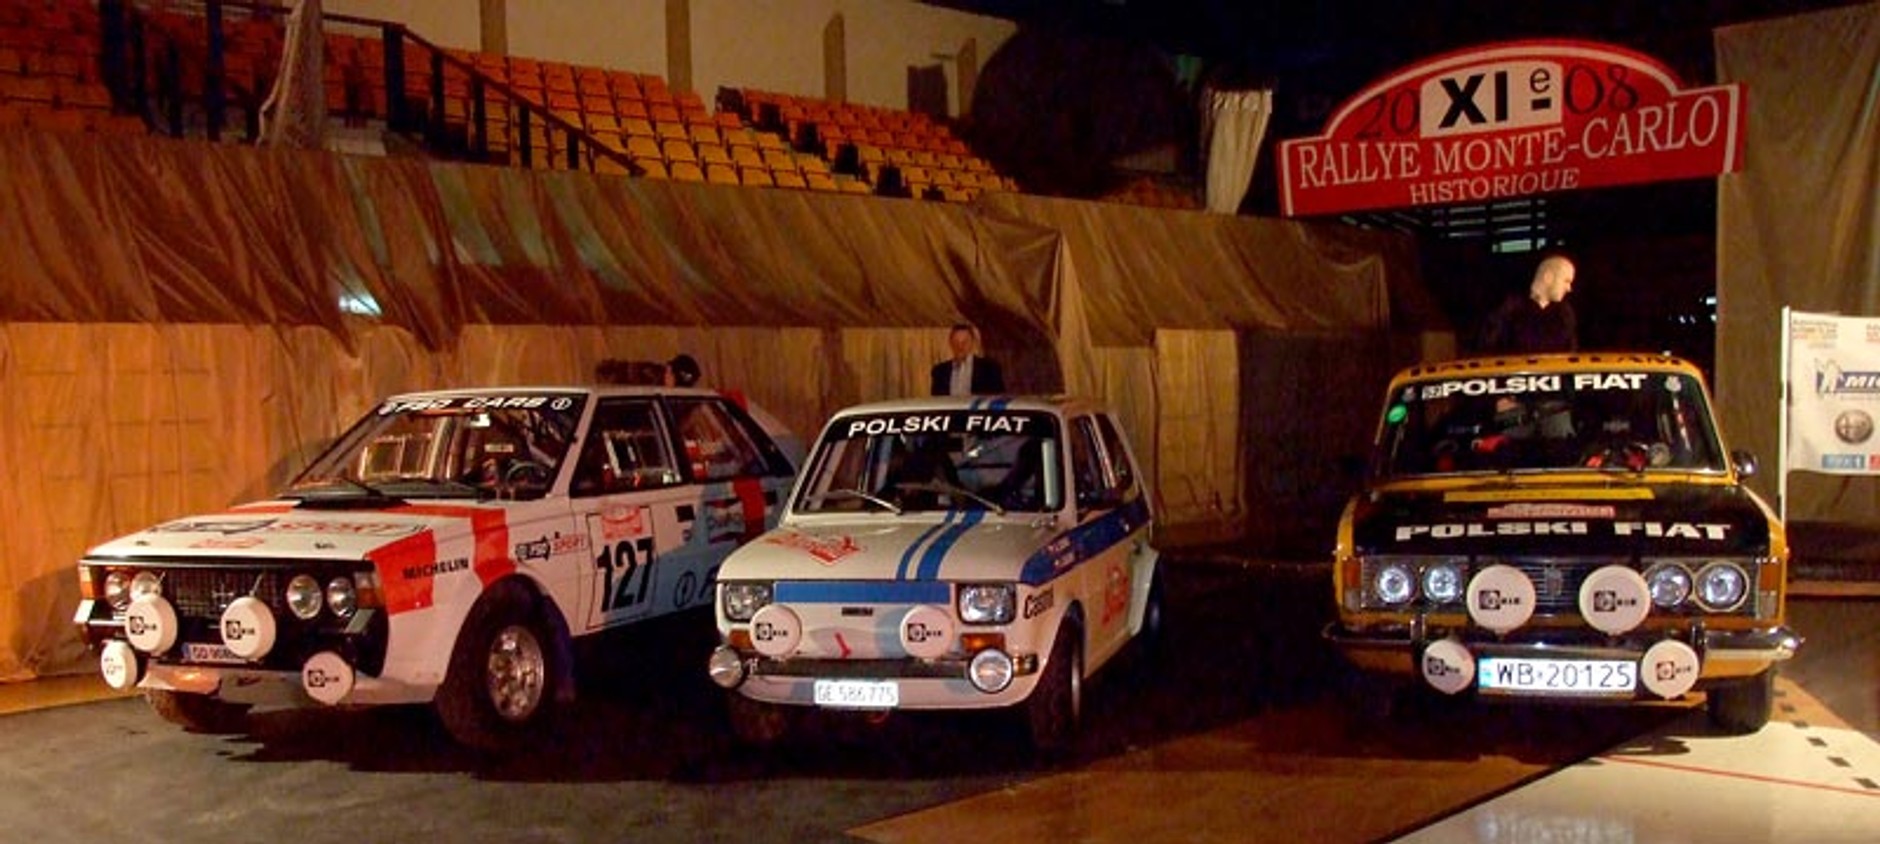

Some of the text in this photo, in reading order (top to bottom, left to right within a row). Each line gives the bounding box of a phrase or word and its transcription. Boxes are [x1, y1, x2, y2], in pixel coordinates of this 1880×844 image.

[1300, 94, 1721, 189] RALLYE MONTE-CARLO
[1409, 168, 1581, 206] HISTORIQUE
[1442, 376, 1560, 397] POLSKI
[1573, 373, 1647, 391] FIAT
[848, 415, 1031, 438] POLSKI FIAT
[1395, 521, 1732, 542] POLSKI FIAT
[402, 557, 469, 579] MICHELIN
[597, 536, 654, 613] 127
[1496, 663, 1534, 686] WB
[1546, 663, 1631, 687] 20125
